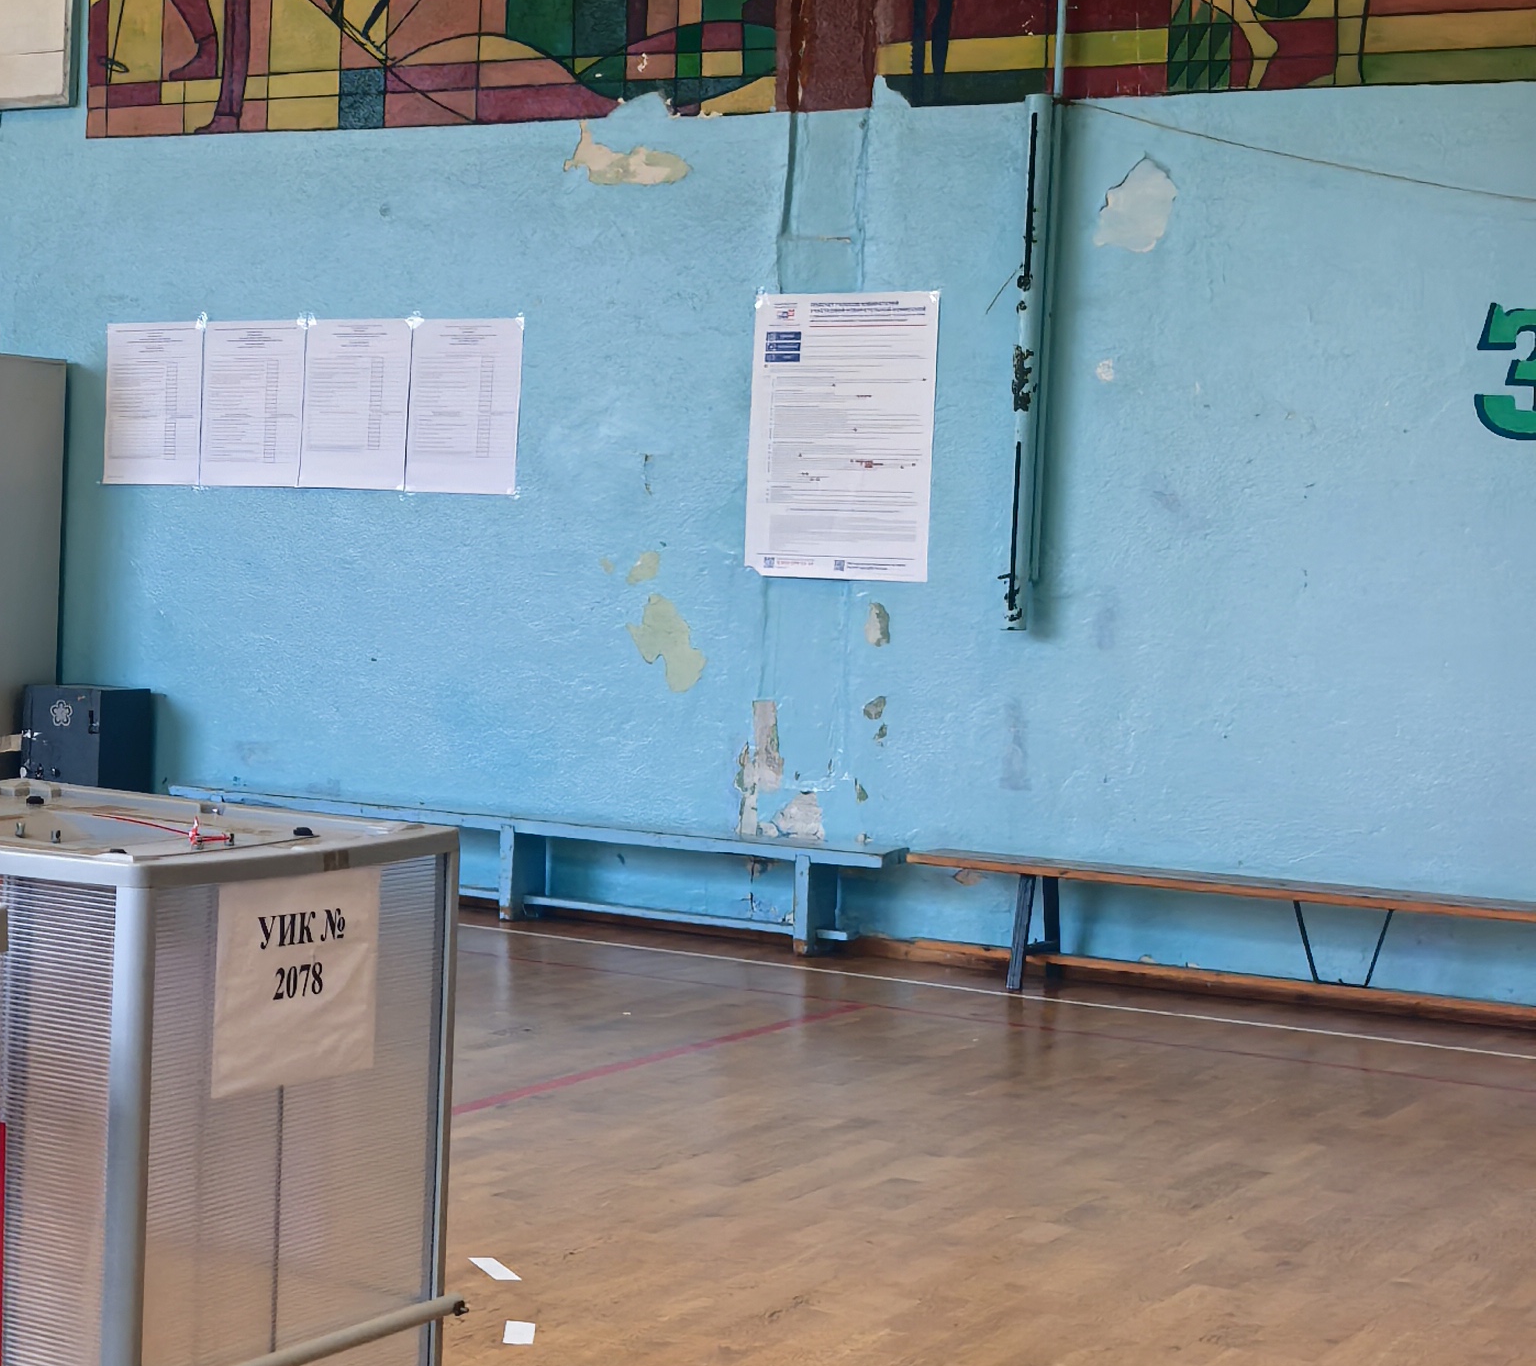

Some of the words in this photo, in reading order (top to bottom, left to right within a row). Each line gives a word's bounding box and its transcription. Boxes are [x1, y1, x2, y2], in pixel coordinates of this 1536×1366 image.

[257, 911, 316, 950] УИК
[320, 907, 346, 942] №
[272, 961, 324, 1001] 2078
